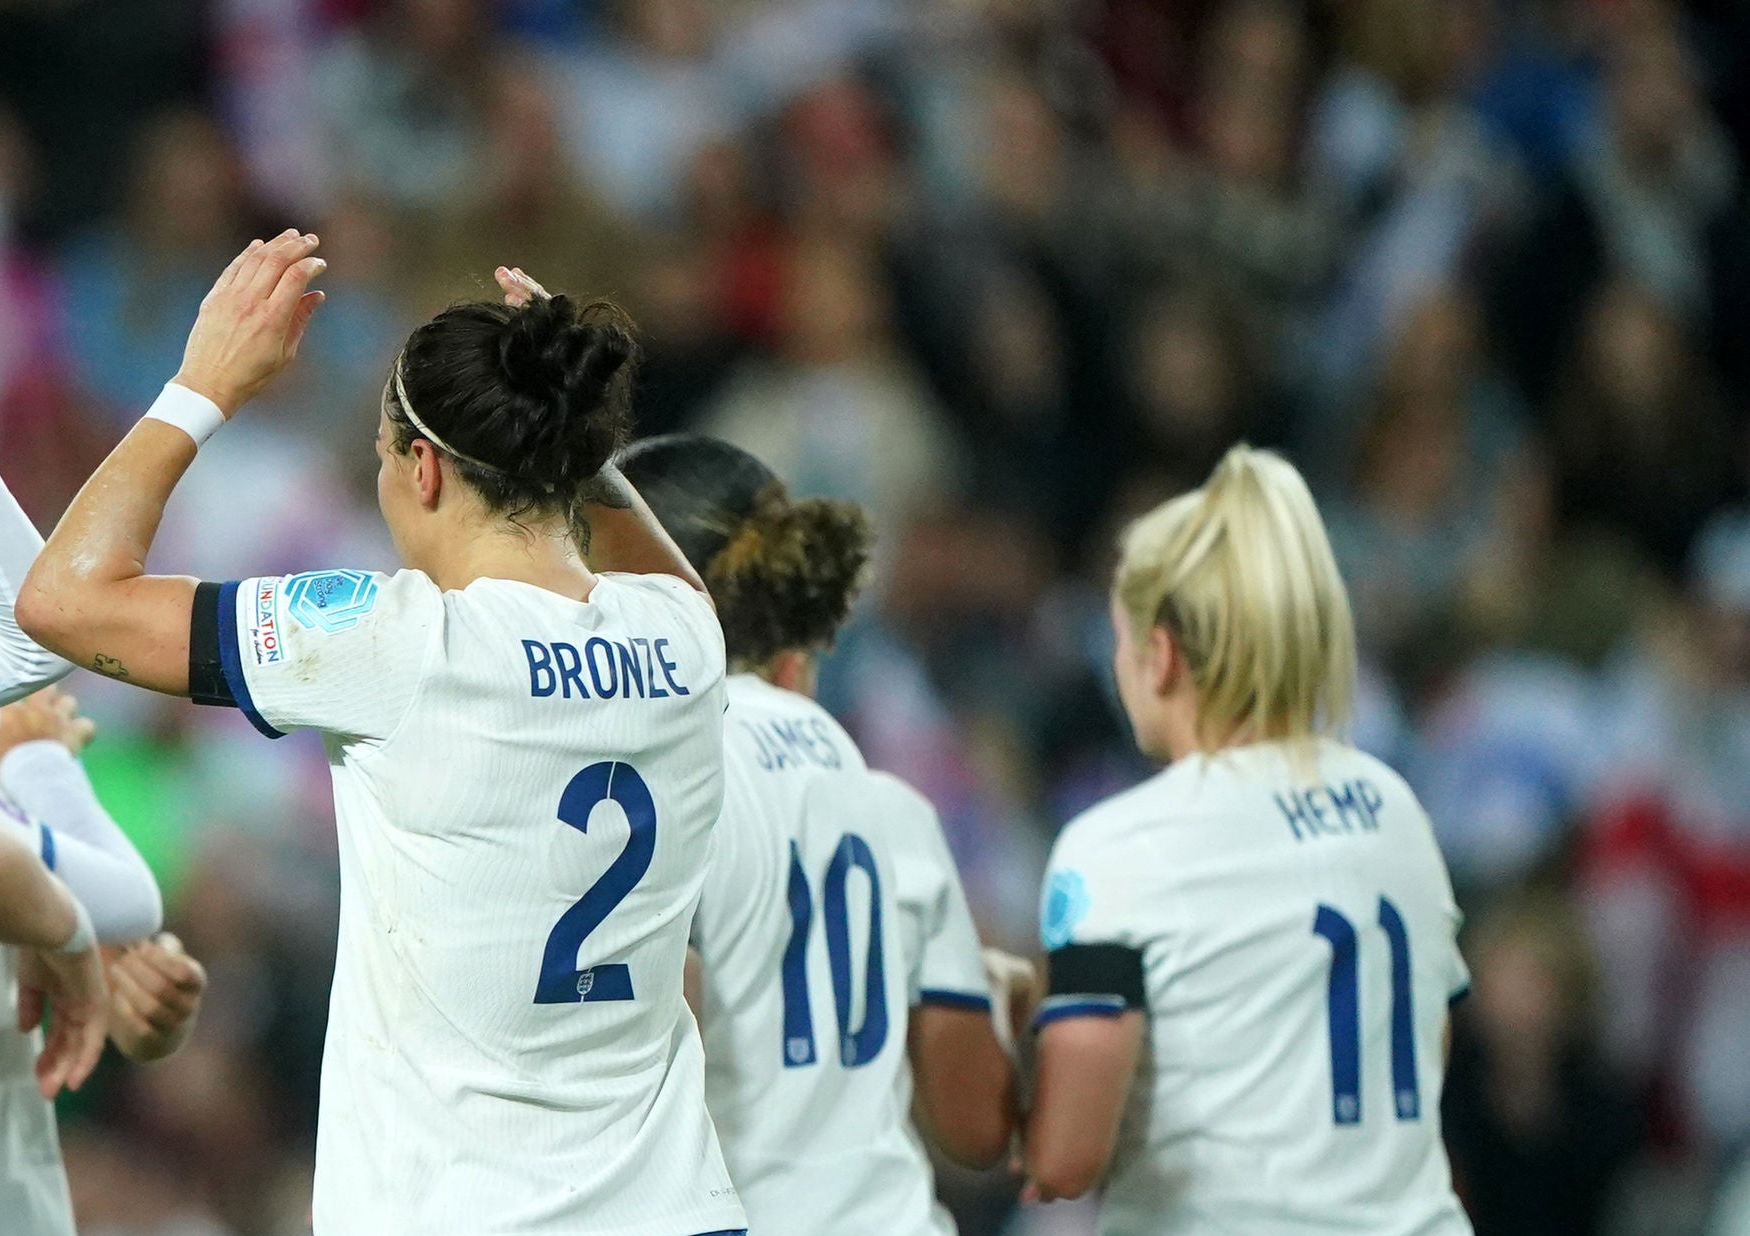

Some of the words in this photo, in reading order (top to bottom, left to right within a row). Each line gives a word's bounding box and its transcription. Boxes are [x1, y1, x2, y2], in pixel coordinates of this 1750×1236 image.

[259, 580, 279, 662] UNDATION
[521, 636, 690, 700] BRONZE
[737, 717, 843, 772] JAMES
[1272, 777, 1383, 841] HEMP
[533, 761, 657, 1004] 2
[781, 832, 889, 1068] 10
[1312, 890, 1420, 1126] 11
